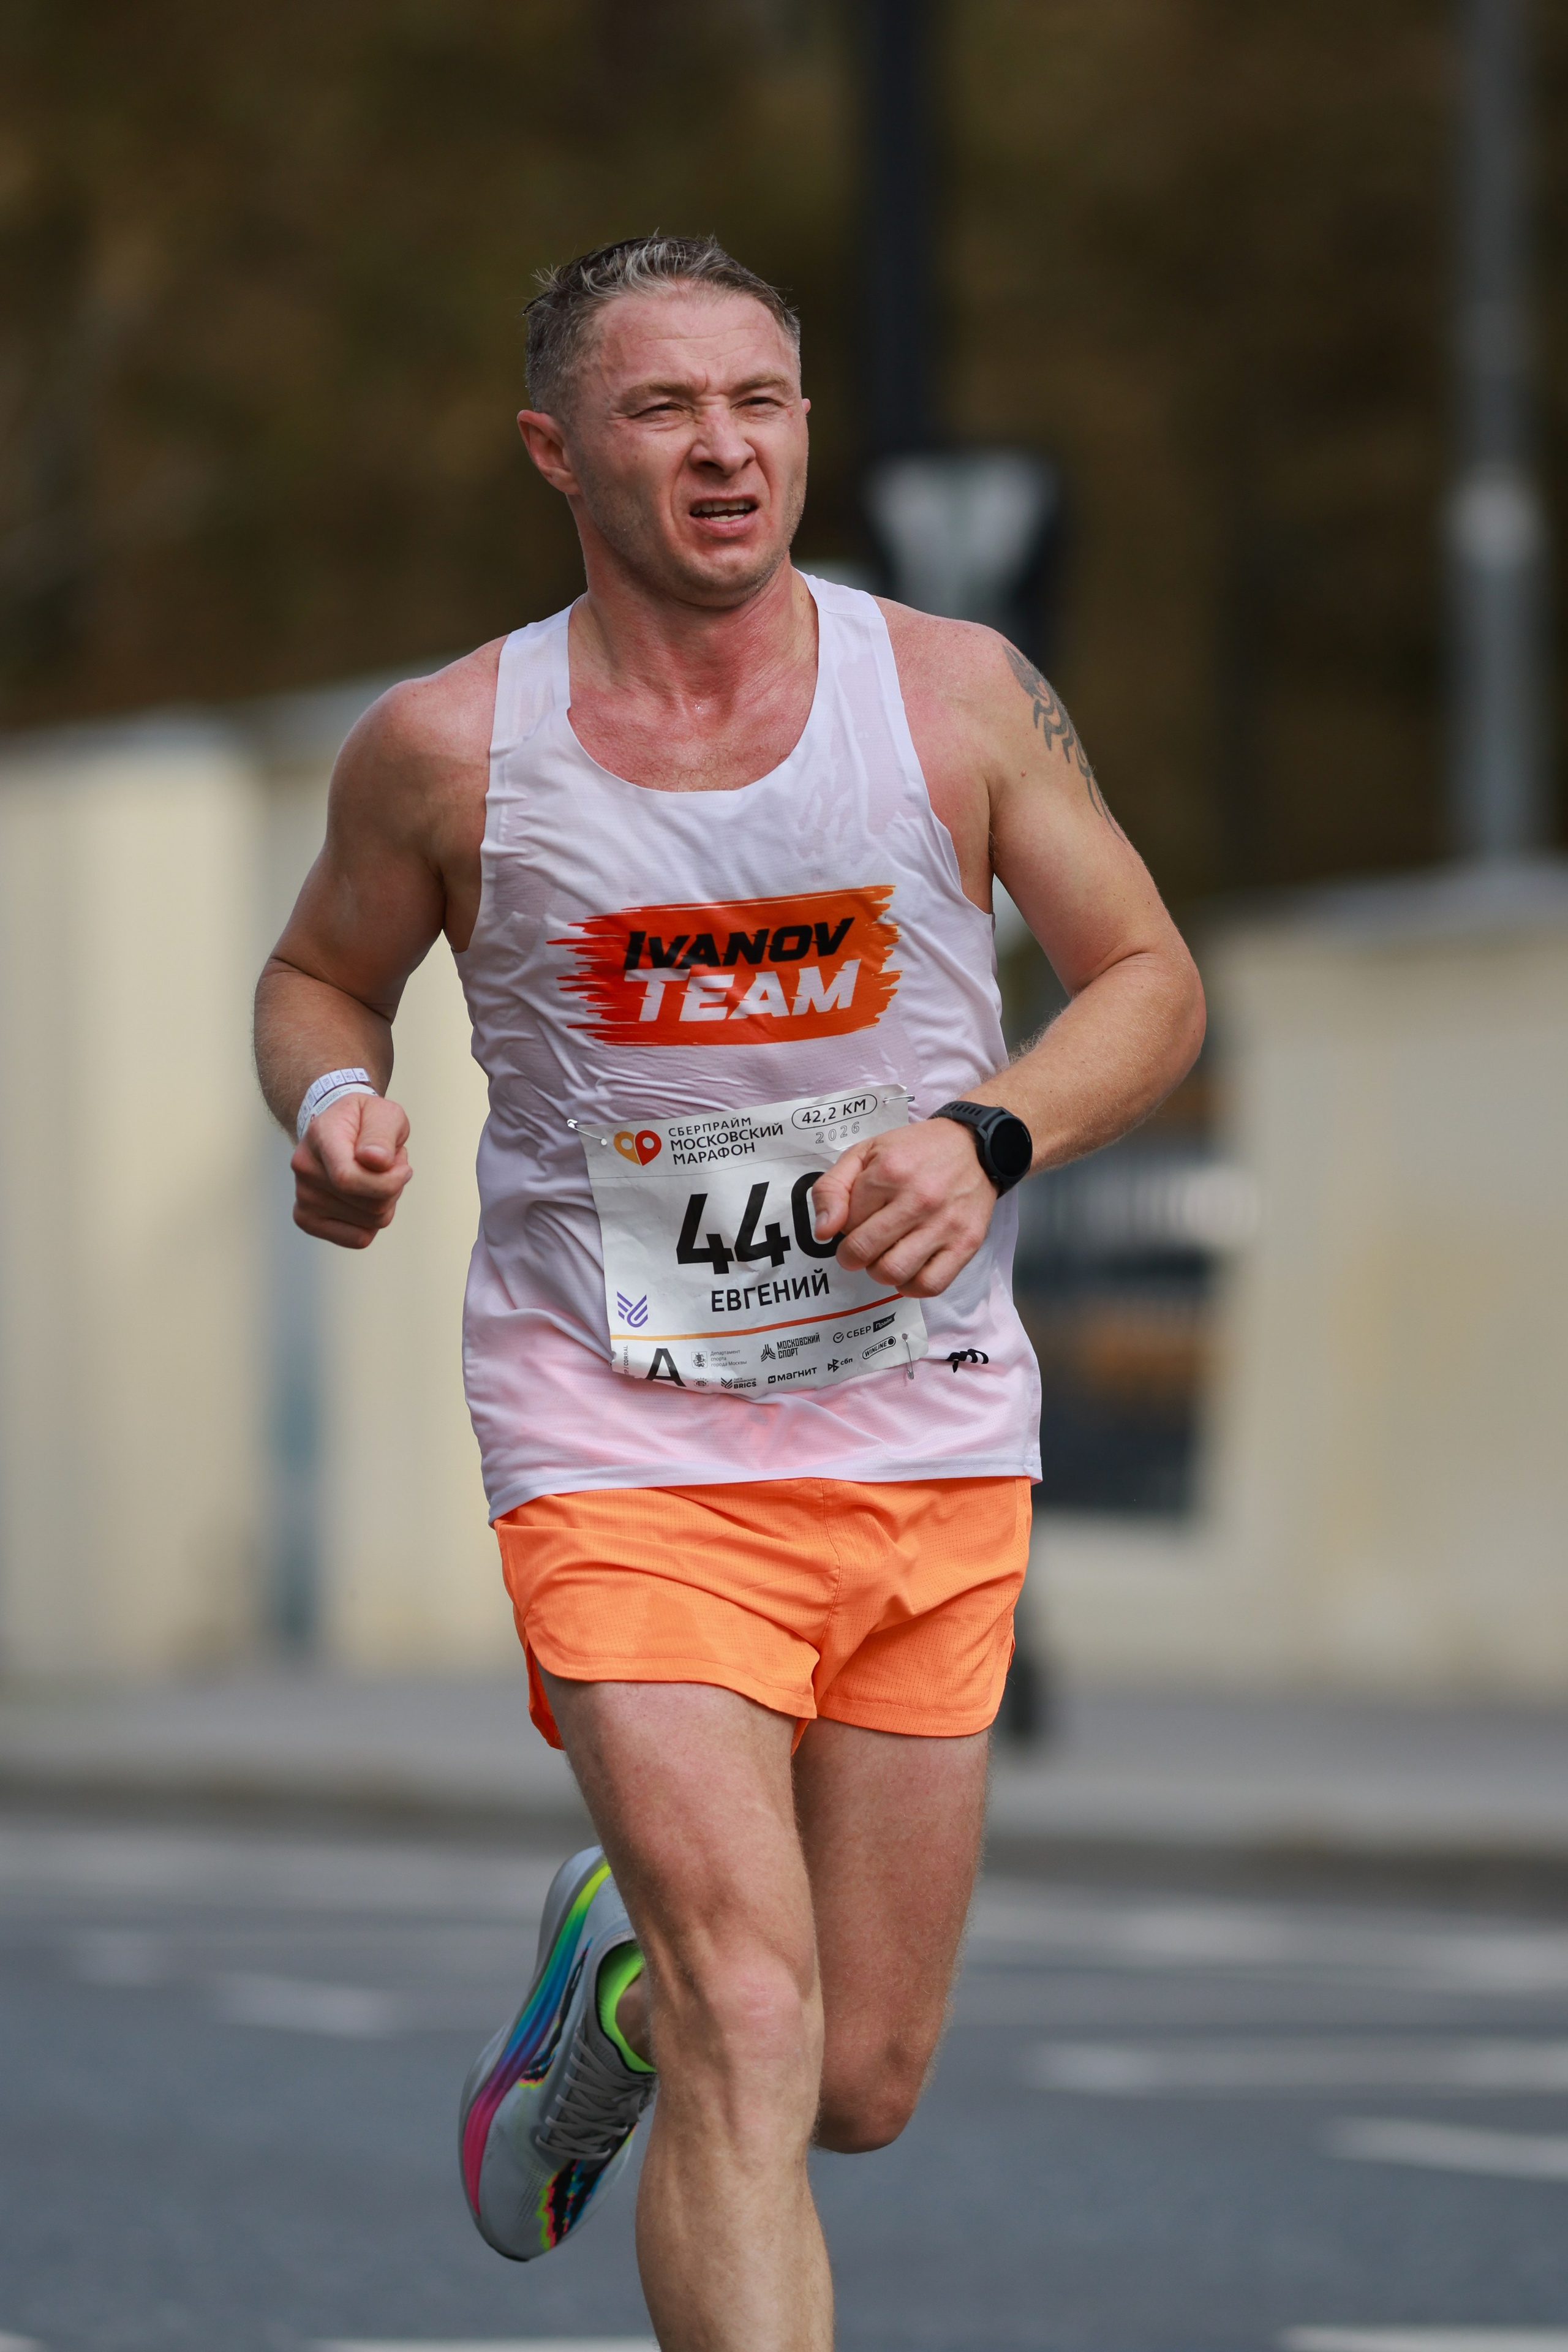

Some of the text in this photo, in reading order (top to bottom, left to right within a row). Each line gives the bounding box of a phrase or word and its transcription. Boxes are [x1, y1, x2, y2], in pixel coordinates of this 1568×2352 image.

[623, 917, 855, 970] IVANOV
[624, 959, 861, 1022] TEAM
[801, 1107, 836, 1124] 42,2
[668, 1117, 752, 1137] СБЕРПРАЙМ
[670, 1123, 783, 1152] МОСКОВСКИЙ
[815, 1121, 860, 1144] 2026
[673, 1142, 755, 1165] МАРАФОН
[711, 1268, 830, 1312] ЕВГЕНИЙ
[777, 1332, 820, 1351] МОСКОВСКИЙ
[846, 1325, 872, 1339] СБЕР
[778, 1348, 799, 1359] СПОРТ
[864, 1340, 888, 1357] WINLINE
